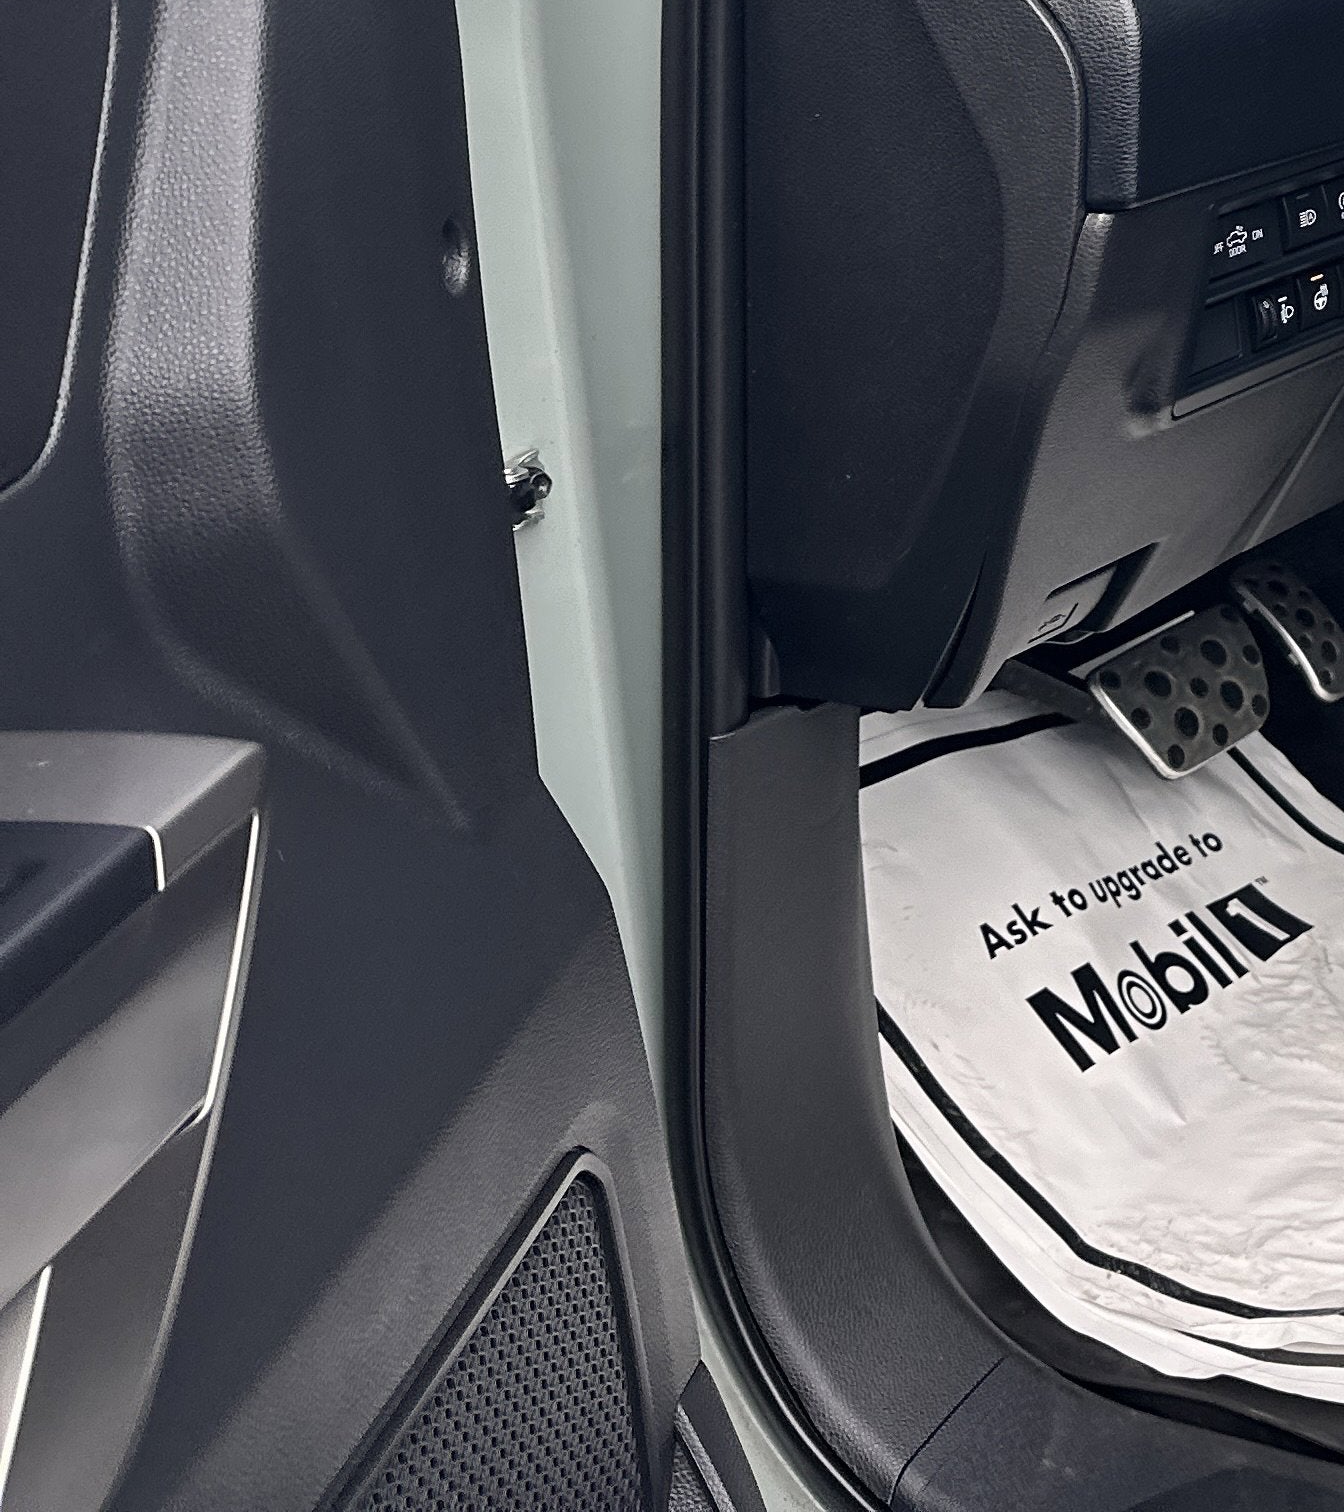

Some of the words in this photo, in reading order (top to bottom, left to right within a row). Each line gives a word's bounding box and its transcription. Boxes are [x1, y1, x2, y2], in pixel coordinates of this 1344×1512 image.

[1252, 228, 1264, 240] ON
[979, 903, 1054, 960] Ask
[1050, 888, 1088, 918] to
[1088, 841, 1193, 908] upgrade
[1188, 832, 1223, 858] to
